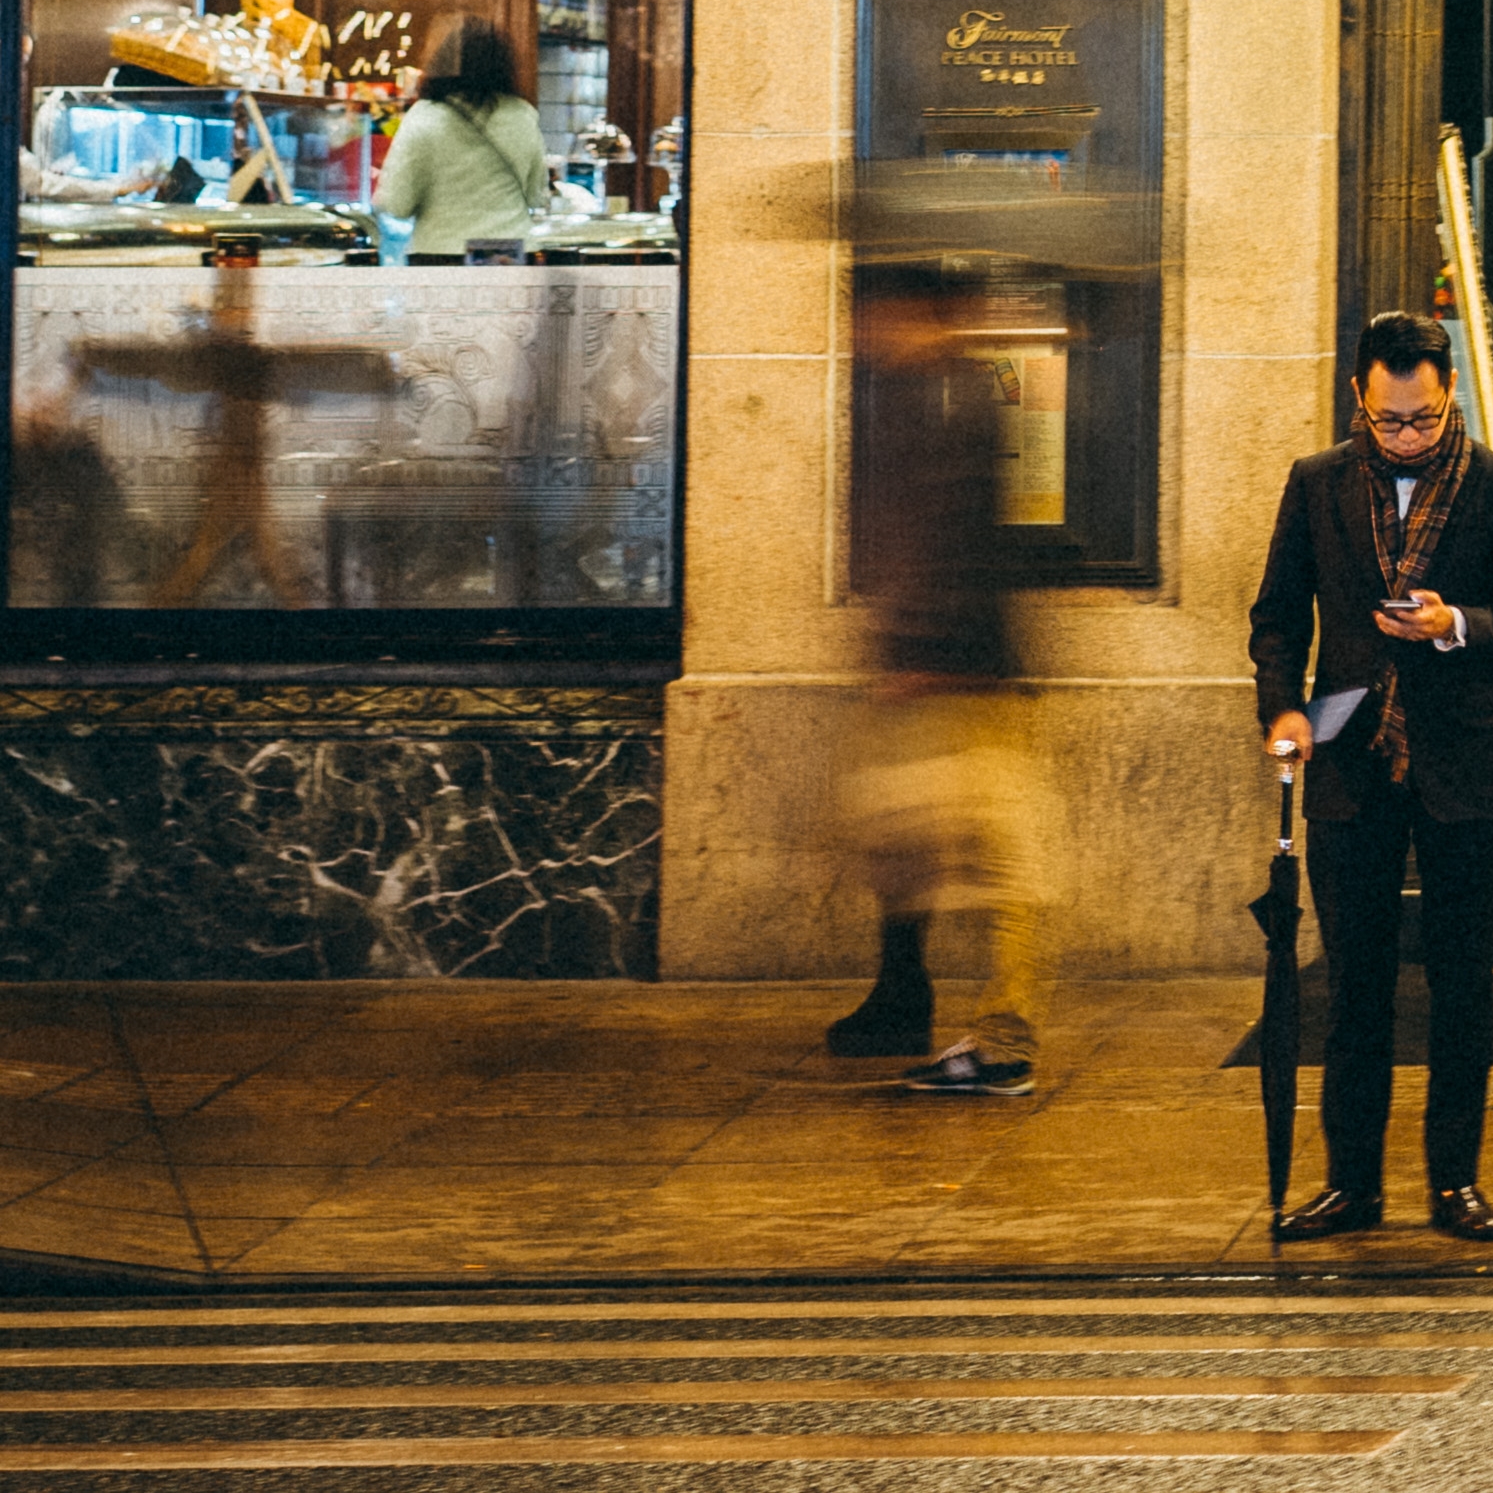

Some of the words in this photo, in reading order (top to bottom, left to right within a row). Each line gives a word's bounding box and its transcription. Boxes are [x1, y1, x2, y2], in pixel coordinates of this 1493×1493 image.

[946, 10, 1074, 49] Fairmont
[941, 50, 1004, 65] PEACE
[1009, 50, 1079, 65] HOTEL
